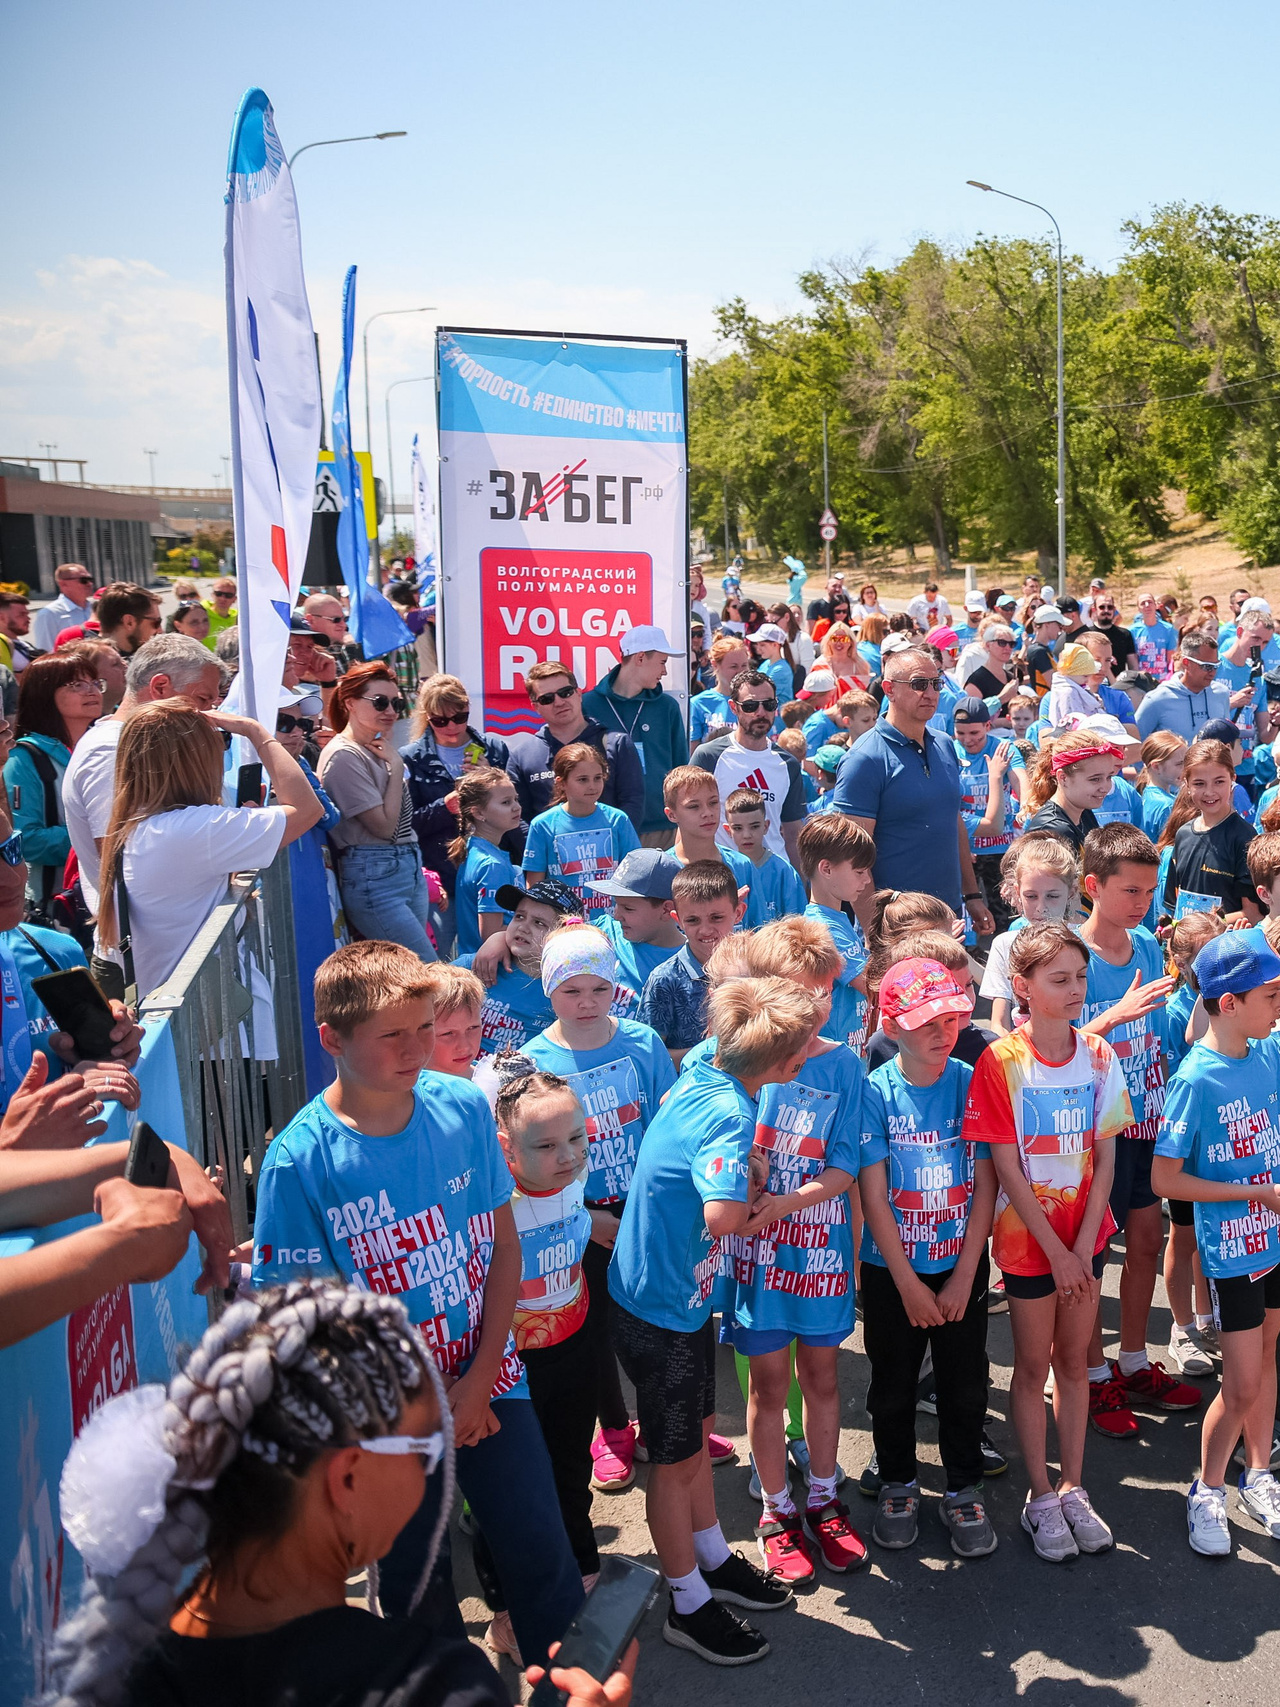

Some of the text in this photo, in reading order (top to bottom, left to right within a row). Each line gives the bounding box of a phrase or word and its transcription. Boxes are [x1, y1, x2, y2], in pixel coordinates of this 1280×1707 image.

[443, 346, 683, 433] #ГОРДОСТЬ #ЕДИНСТВО #МЕЧТА
[497, 565, 637, 580] ВОЛГОГРАДСКИЙ
[497, 581, 637, 595] ПОЛУМАРАФОН
[499, 607, 634, 637] VOLGA
[575, 843, 597, 860] 1147
[580, 858, 598, 871] 1КМ
[1, 970, 15, 994] ПСБ
[1129, 1038, 1146, 1056] 1КМ
[582, 1086, 620, 1116] 1109
[1217, 1096, 1252, 1125] 2024
[594, 1111, 621, 1134] 1КМ
[775, 1104, 817, 1135] 1083
[1052, 1107, 1087, 1134] 1001
[1227, 1108, 1271, 1141] #МЕЧТА
[773, 1132, 805, 1156] 1КМ
[1057, 1132, 1084, 1155] 1КМ
[1207, 1124, 1280, 1164] #ЗАБЕГ2024
[914, 1163, 953, 1190] 1085
[921, 1191, 949, 1210] 1КМ
[327, 1189, 397, 1242] 2024
[347, 1203, 449, 1270] #МЕЧТА
[1219, 1231, 1270, 1260] #ЗАБЕГ
[278, 1247, 322, 1265] ПСБ
[537, 1239, 576, 1276] 1080
[806, 1249, 844, 1273] 2024
[543, 1269, 571, 1297] 1КМ
